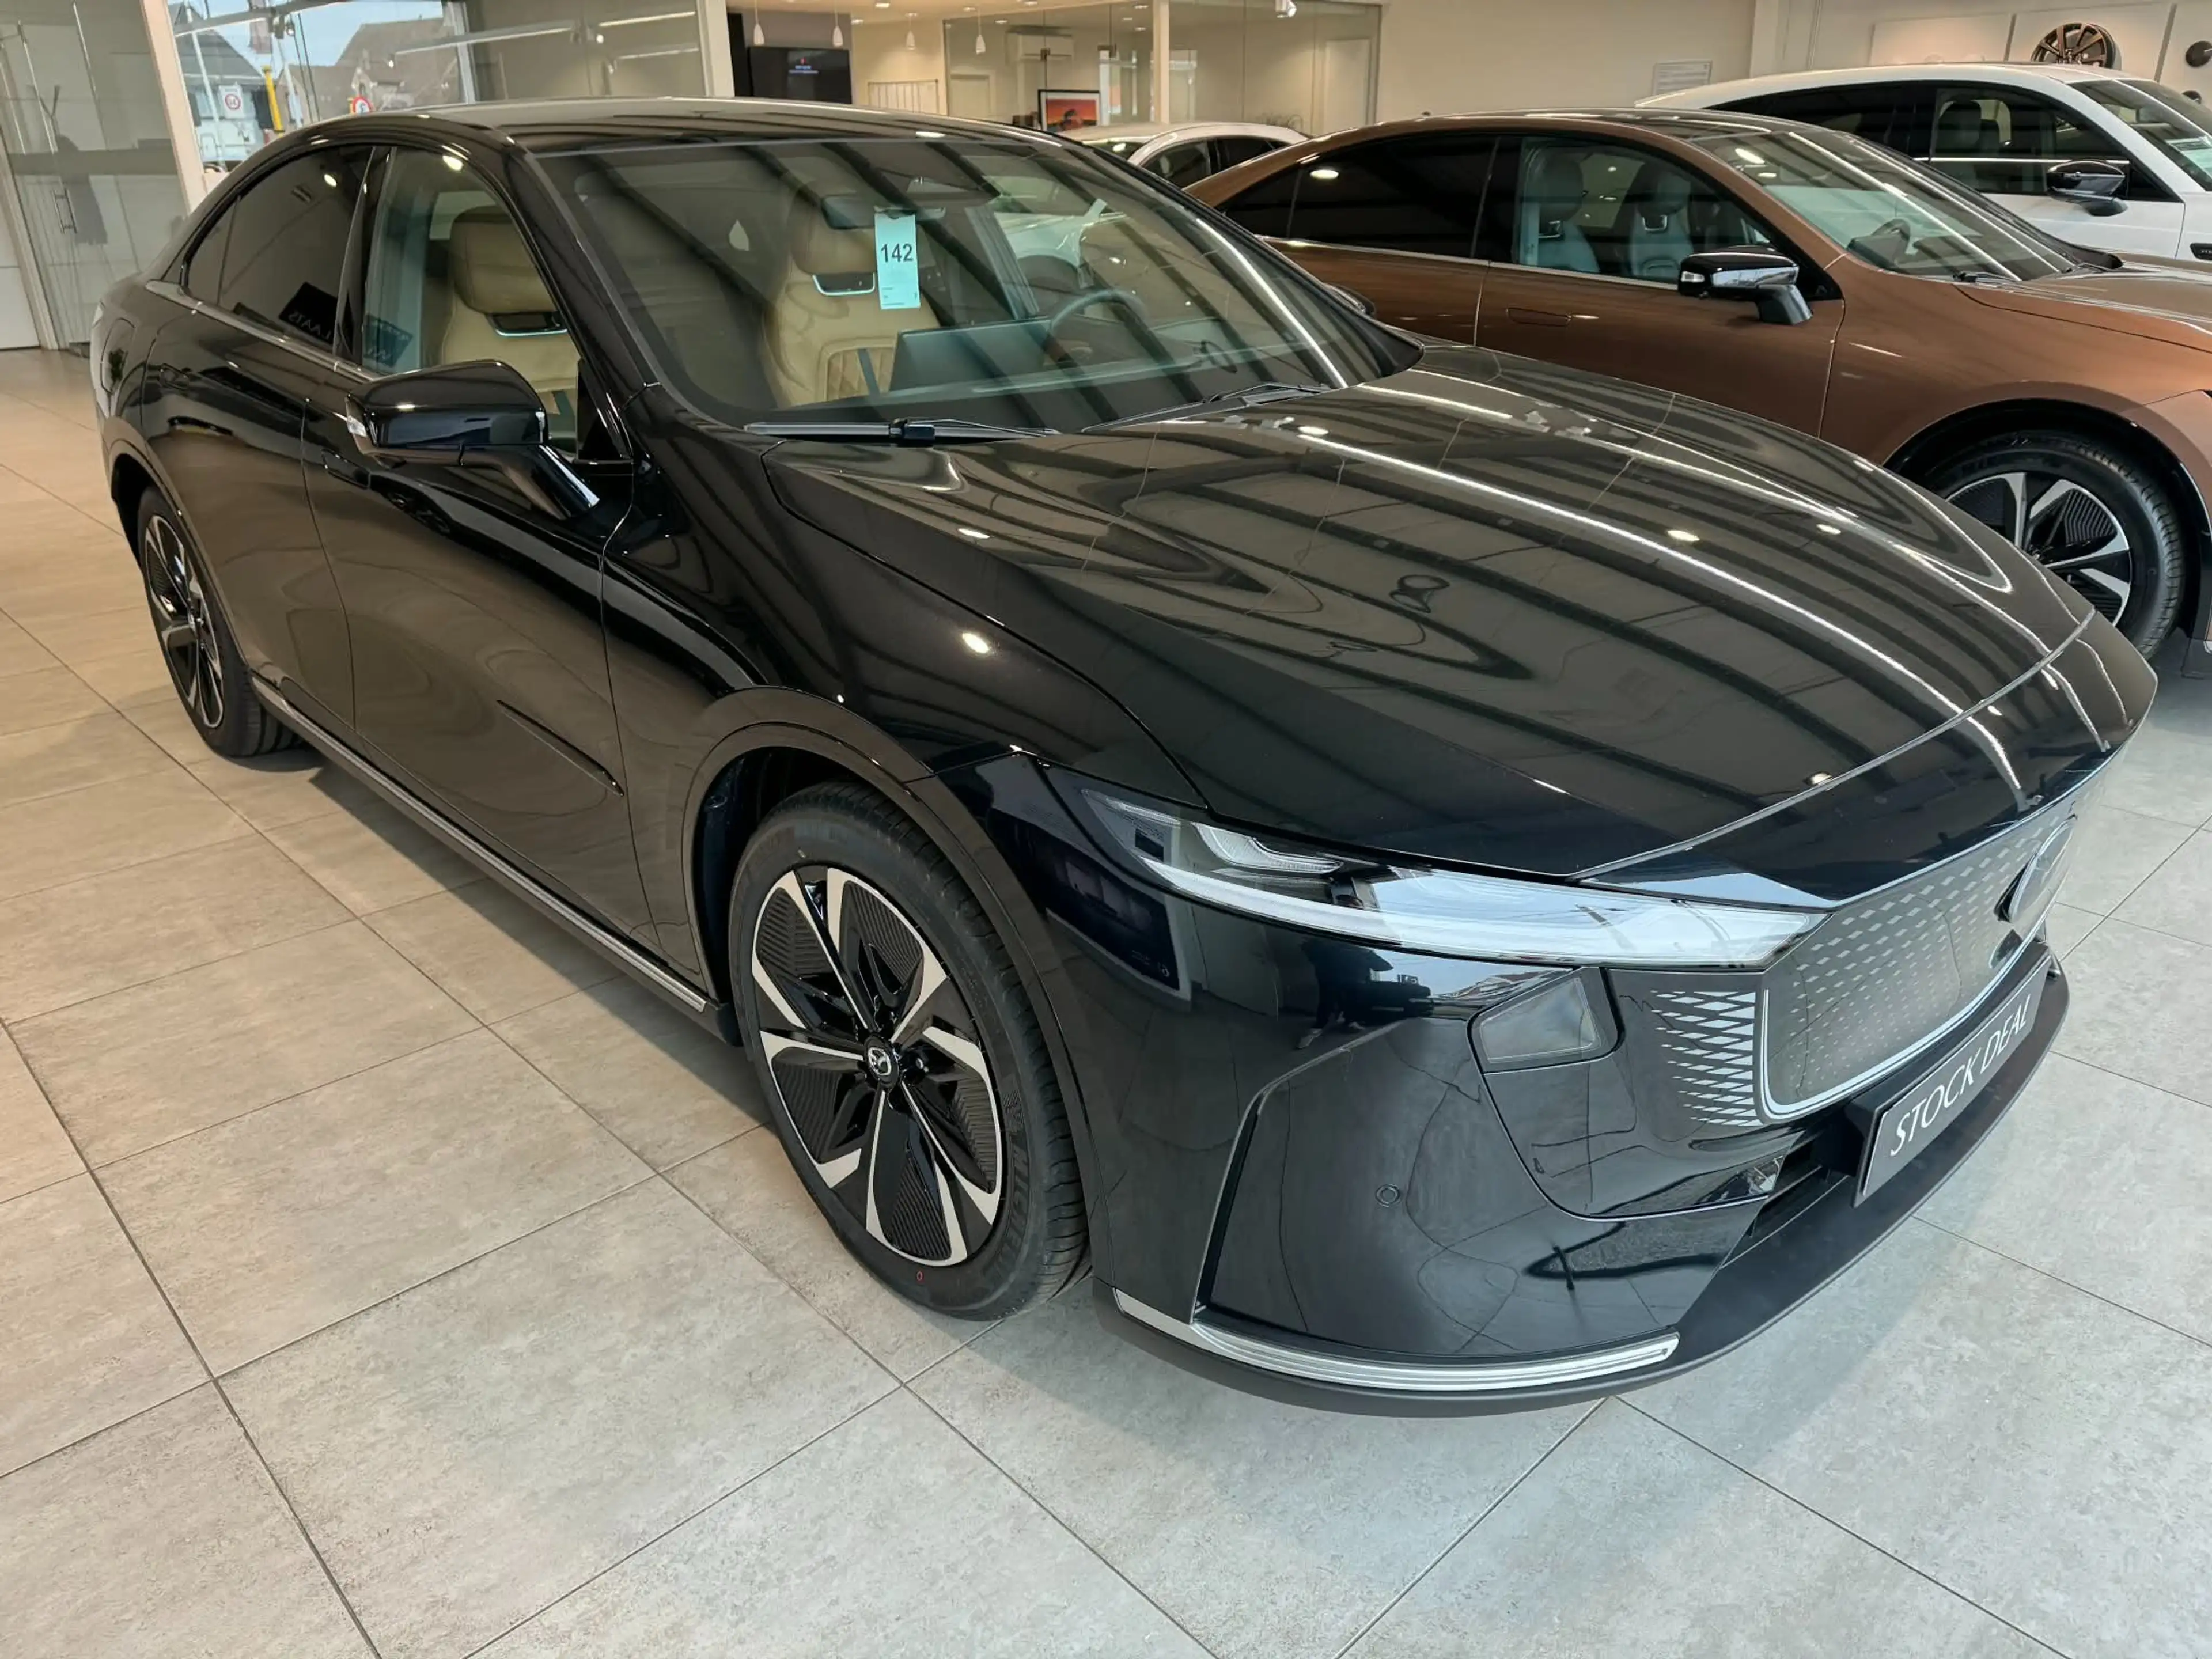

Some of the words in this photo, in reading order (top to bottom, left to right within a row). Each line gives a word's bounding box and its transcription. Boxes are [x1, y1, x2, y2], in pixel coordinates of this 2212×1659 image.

[880, 243, 914, 263] 142
[1890, 1047, 1982, 1156] STOCK
[1979, 993, 2031, 1074] DEAL
